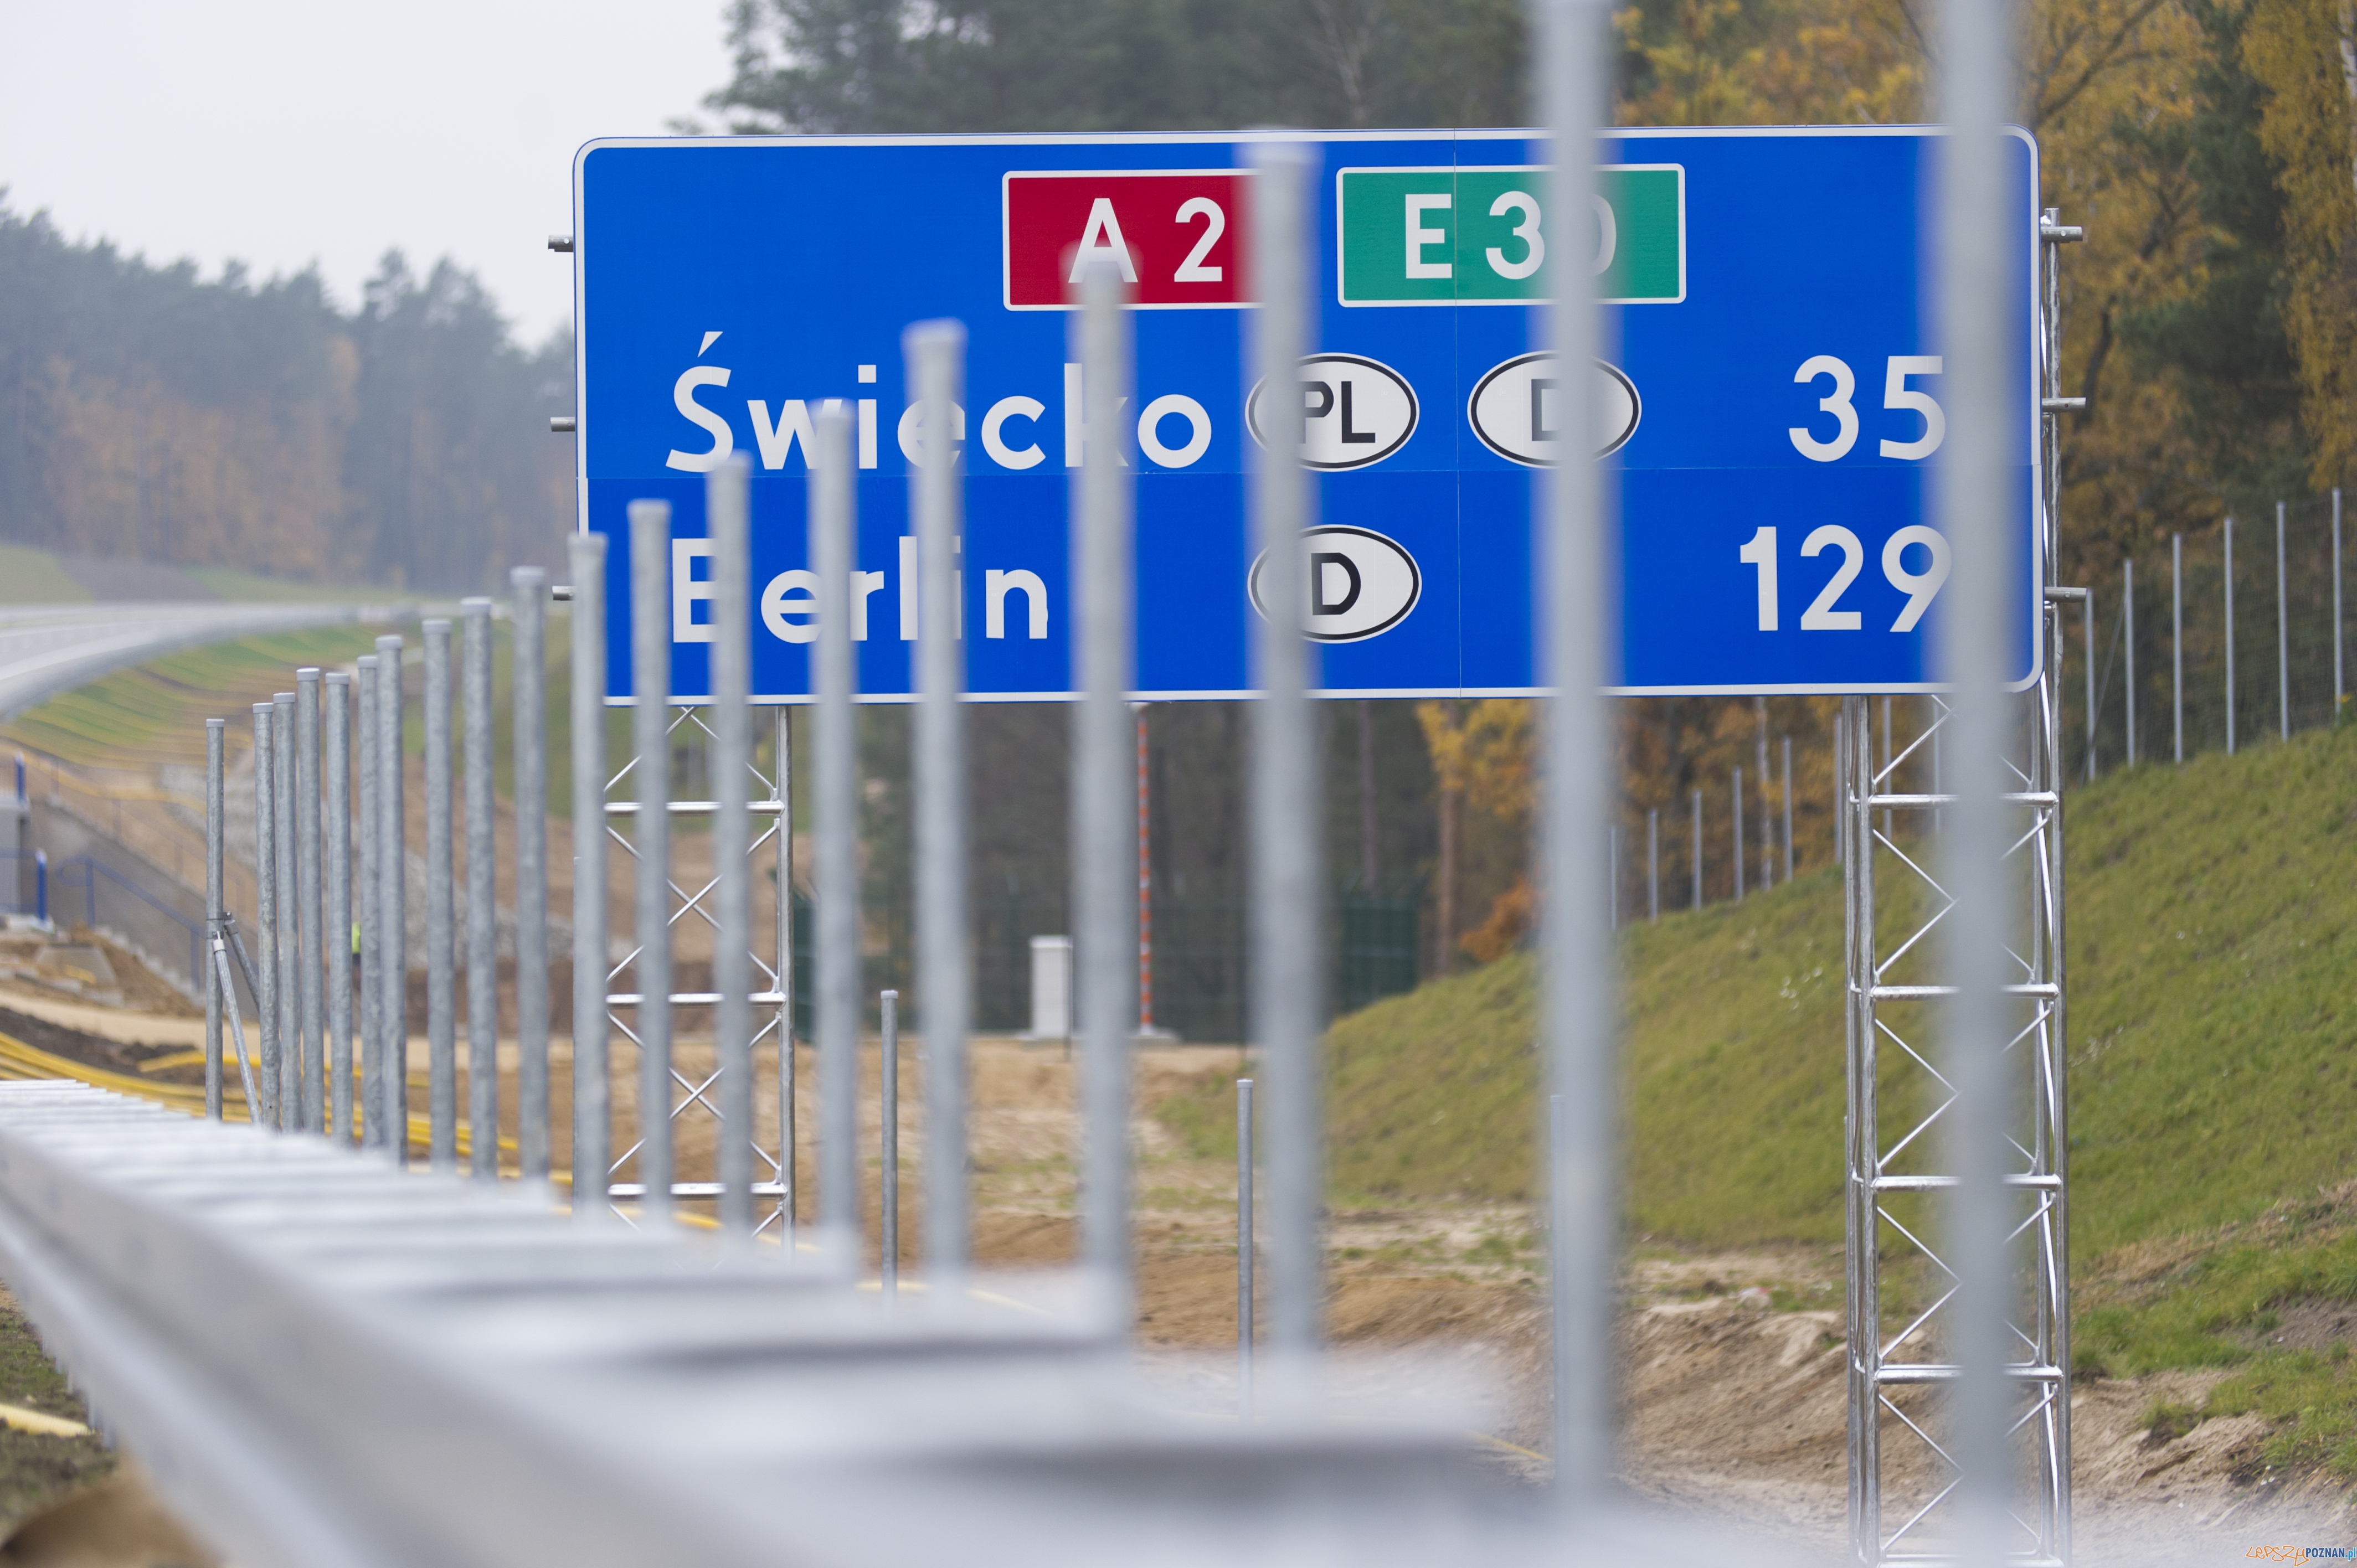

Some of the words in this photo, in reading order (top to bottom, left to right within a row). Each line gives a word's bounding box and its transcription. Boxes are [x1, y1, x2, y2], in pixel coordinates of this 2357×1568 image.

[1068, 198, 1139, 283] A
[1174, 197, 1226, 282] 2
[1405, 193, 1453, 278] E
[1296, 380, 1376, 443] PL
[1789, 354, 1946, 462] 35
[1311, 552, 1362, 616] D
[1740, 524, 1952, 632] 129
